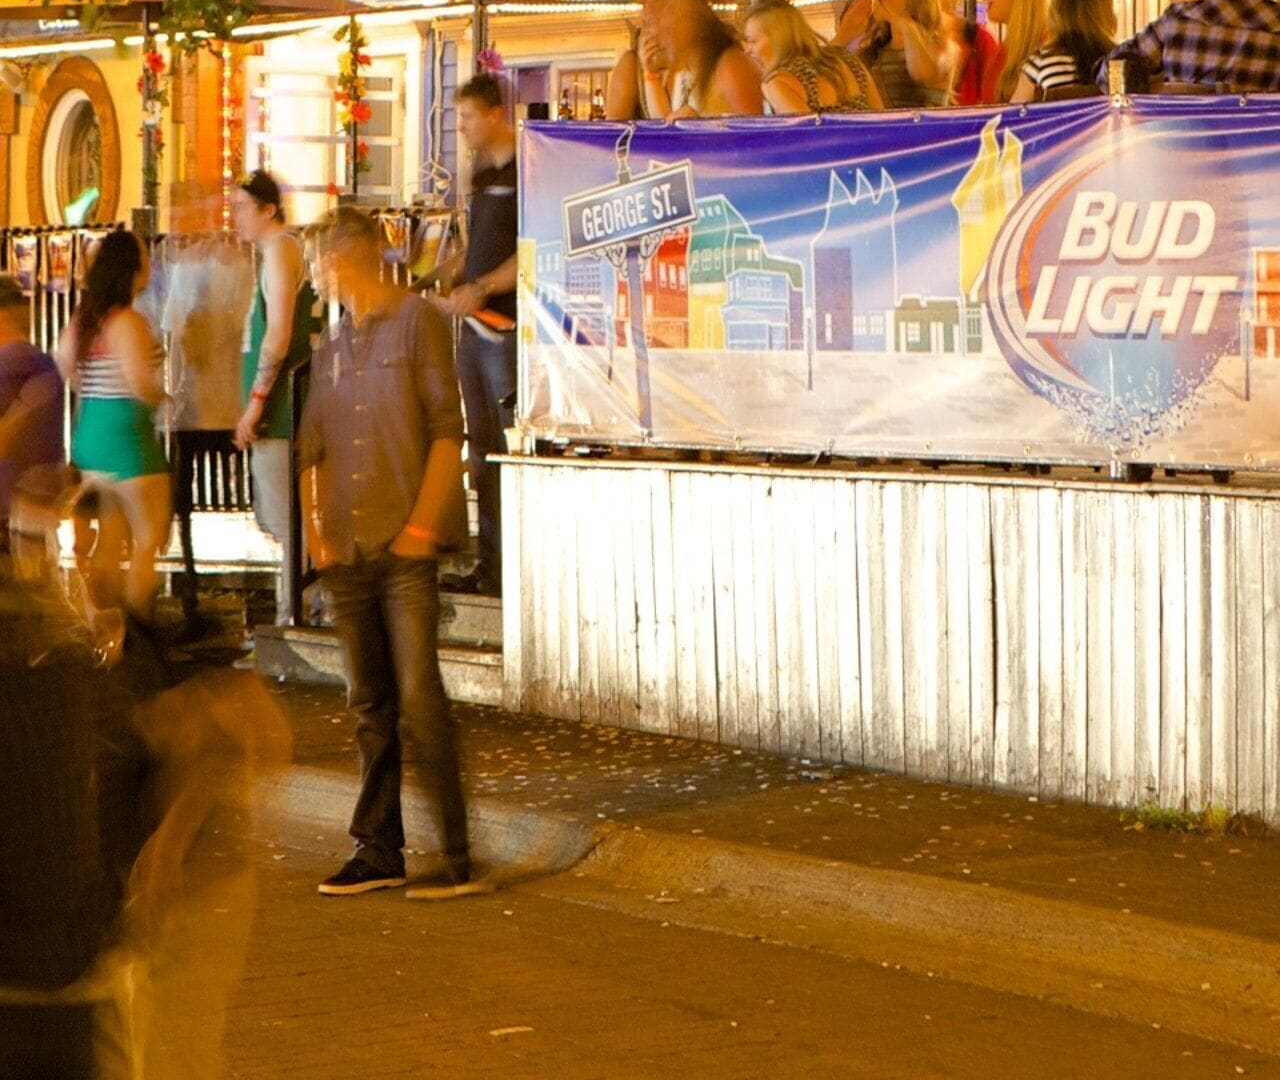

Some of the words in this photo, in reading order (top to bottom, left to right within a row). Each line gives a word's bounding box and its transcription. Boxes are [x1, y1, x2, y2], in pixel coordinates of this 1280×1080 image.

[582, 192, 648, 241] GEORGE
[650, 183, 678, 220] ST.
[1059, 191, 1216, 264] BUD
[1025, 265, 1239, 339] LIGHT
